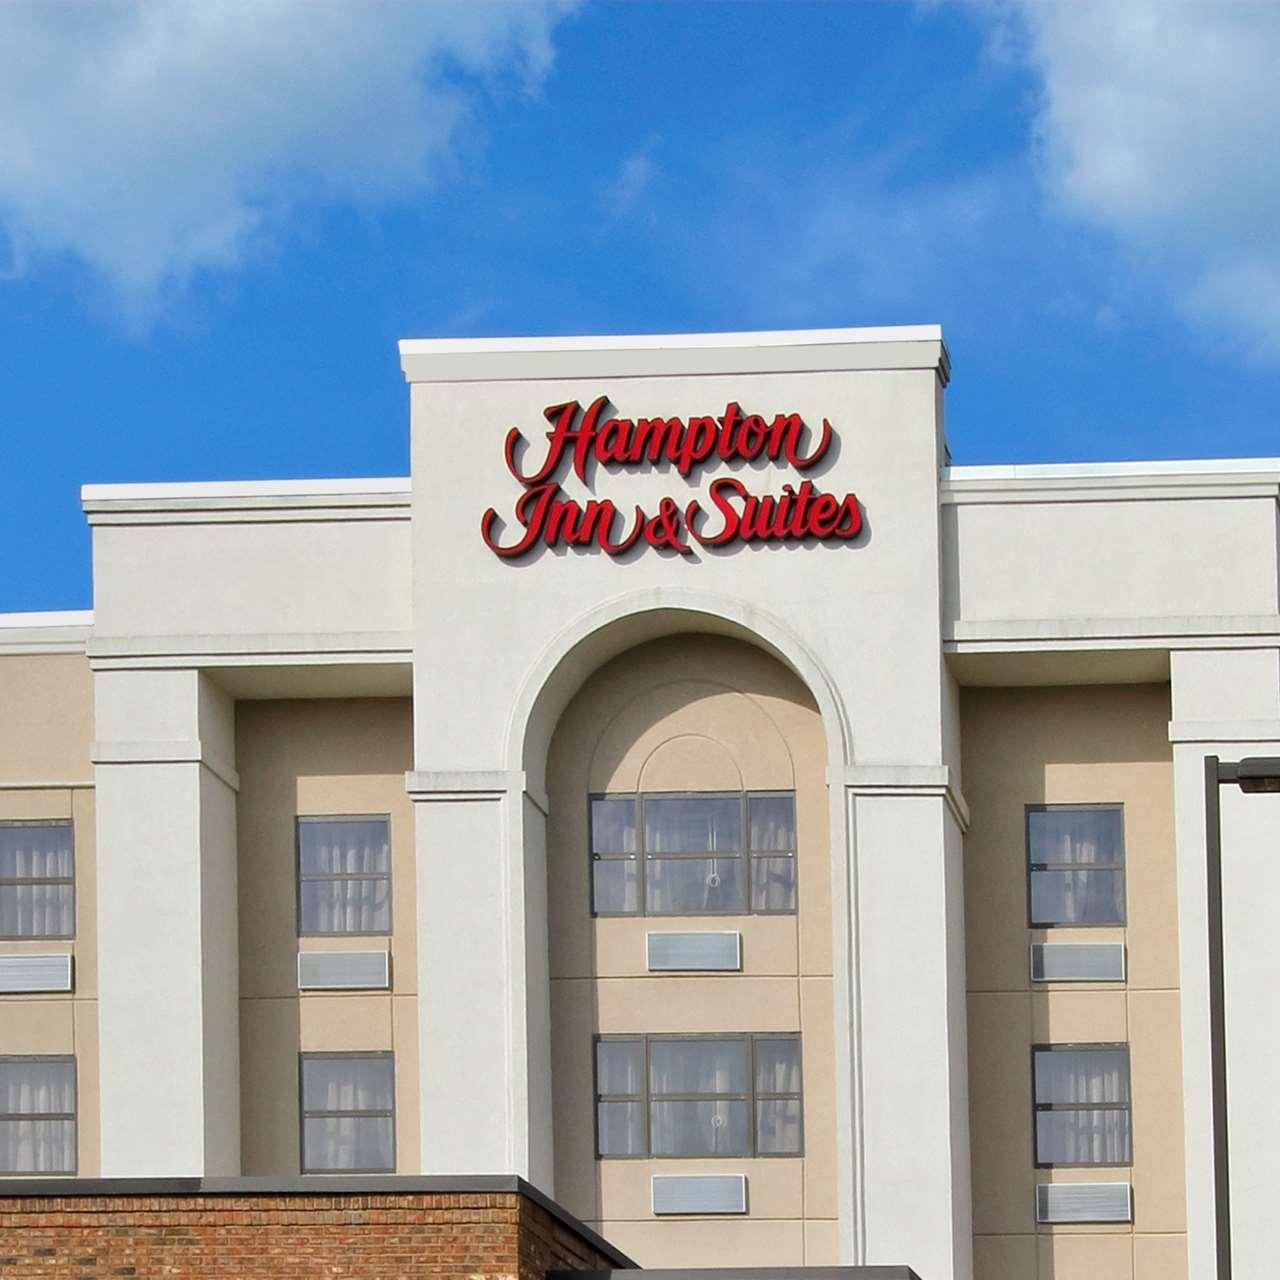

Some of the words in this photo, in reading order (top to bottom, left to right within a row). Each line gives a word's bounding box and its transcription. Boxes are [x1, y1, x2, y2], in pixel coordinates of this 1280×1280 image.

[505, 396, 831, 485] Hampton
[481, 483, 644, 555] Inn
[644, 497, 691, 553] &
[685, 477, 863, 544] Suites
